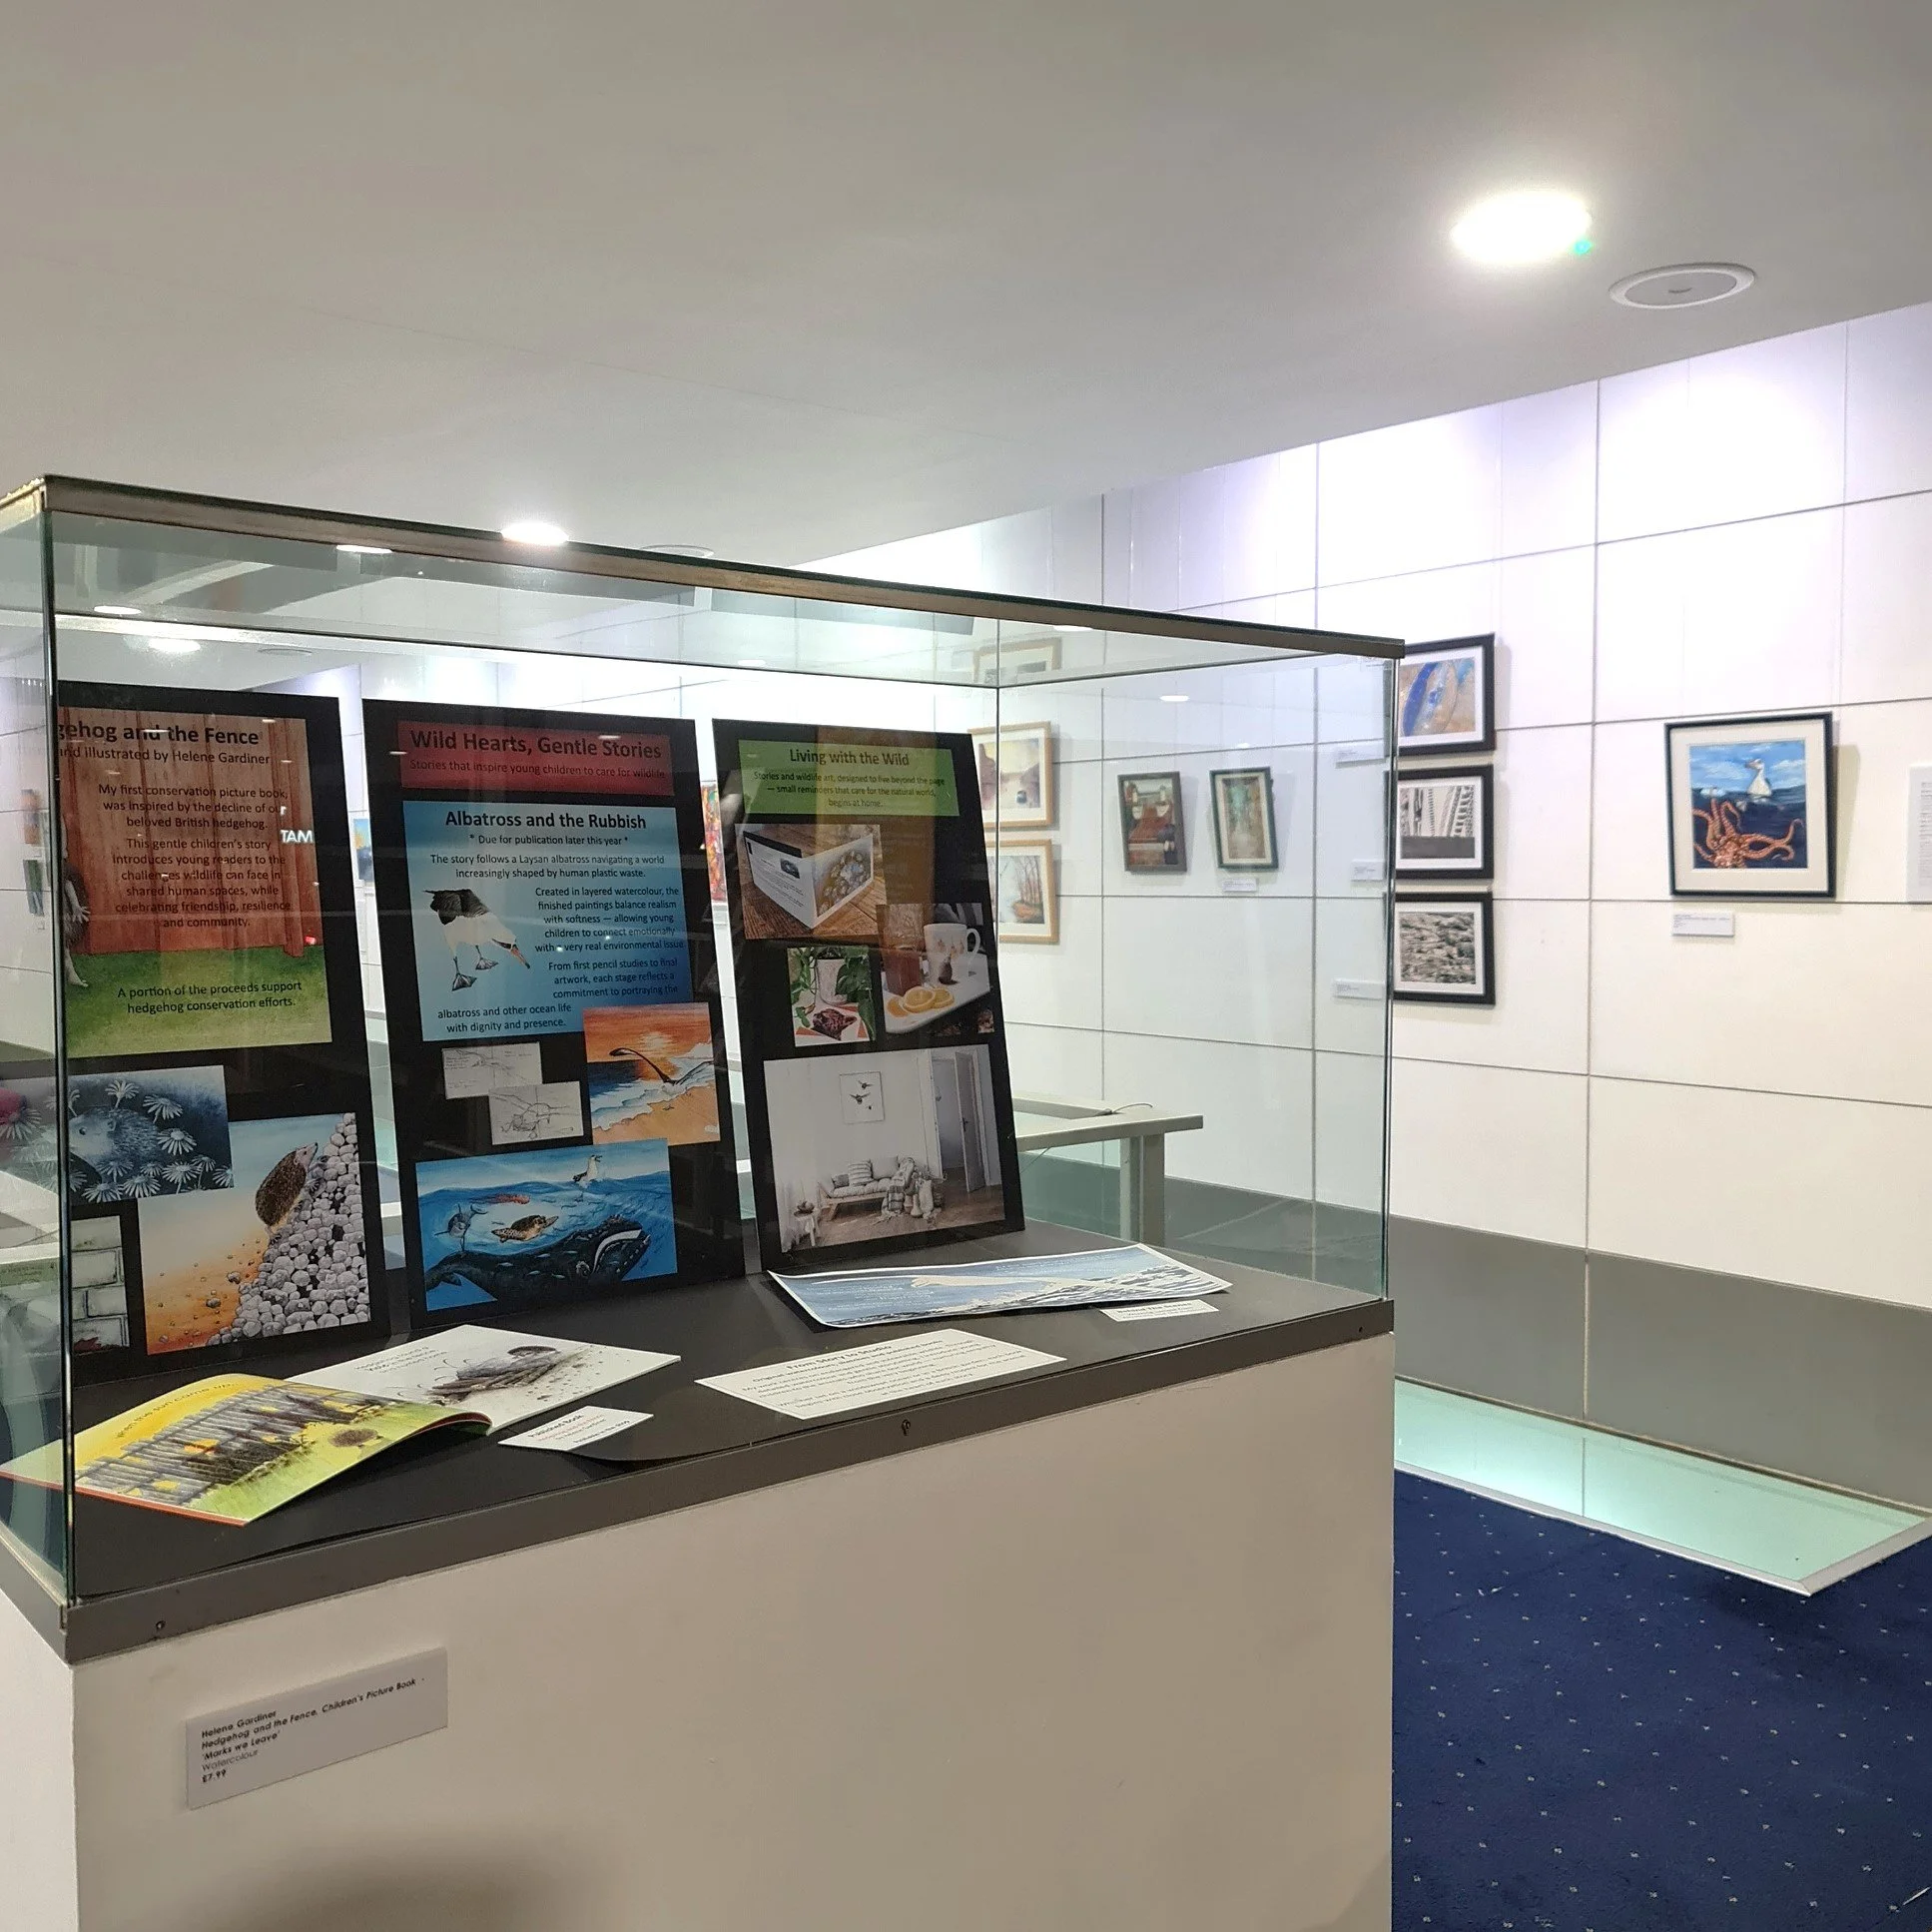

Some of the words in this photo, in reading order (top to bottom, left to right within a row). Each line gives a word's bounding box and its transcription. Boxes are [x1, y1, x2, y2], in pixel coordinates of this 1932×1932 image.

[123, 723, 160, 741] and
[168, 724, 199, 742] the
[205, 727, 260, 745] Fence
[410, 730, 456, 749] Wild
[463, 733, 532, 756] Hearts,
[537, 737, 597, 756] Gentle
[602, 739, 662, 759] Stories
[85, 746, 150, 761] illustrated
[154, 749, 169, 763] by
[172, 750, 216, 764] Helene
[218, 751, 271, 765] Gardiner
[790, 749, 826, 765] Living
[829, 751, 857, 763] with
[860, 752, 879, 764] the
[883, 754, 910, 766] Wild
[410, 760, 446, 771] Stories
[449, 761, 470, 771] that
[473, 763, 507, 774] inspire
[510, 765, 539, 775] young
[542, 764, 581, 775] children
[596, 768, 614, 777] care
[838, 774, 868, 783] designed
[99, 785, 117, 795] My
[121, 785, 142, 794] first
[146, 786, 216, 797] conservation
[220, 788, 256, 798] picture
[260, 787, 289, 799] book,
[129, 802, 174, 814] inspired
[178, 802, 190, 814] by
[215, 803, 252, 813] decline
[256, 804, 266, 813] of
[127, 817, 171, 827] beloved
[175, 817, 209, 827] British
[213, 819, 268, 830] hedgehog.
[445, 811, 521, 827] Albatross
[526, 812, 554, 827] and
[559, 814, 584, 828] the
[589, 815, 646, 829] Rubbish
[127, 839, 149, 849] This
[153, 839, 187, 850] gentle
[245, 841, 271, 851] story
[478, 835, 496, 844] Due
[499, 835, 511, 845] for
[515, 836, 564, 846] publication
[566, 836, 585, 845] later
[587, 836, 602, 845] this
[604, 838, 621, 847] year
[113, 855, 173, 865] introduces
[176, 857, 210, 866] young
[213, 856, 251, 865] readers
[256, 856, 266, 865] to
[270, 855, 285, 865] the
[430, 855, 448, 864] The
[451, 856, 474, 866] story
[477, 855, 509, 864] follows
[519, 855, 548, 866] Laysan
[551, 855, 589, 864] albatross
[592, 856, 633, 866] navigating
[247, 871, 268, 880] face
[455, 869, 510, 880] increasingly
[512, 869, 544, 880] shaped
[547, 869, 558, 879] by
[559, 869, 589, 878] human
[592, 869, 618, 880] plastic
[127, 887, 164, 896] shared
[168, 887, 207, 896] human
[251, 886, 279, 895] while
[582, 888, 612, 897] layered
[615, 888, 664, 897] watercolour,
[116, 902, 178, 914] celebrating
[243, 902, 291, 911] resilience
[575, 902, 613, 911] paintings
[164, 918, 183, 928] and
[544, 915, 563, 924] with
[614, 915, 647, 924] allowing
[545, 929, 579, 938] children
[535, 944, 554, 953] with
[585, 942, 601, 951] real
[604, 941, 662, 950] environmental
[593, 961, 617, 970] pencil
[620, 960, 648, 968] studies
[554, 974, 590, 984] artwork,
[593, 973, 612, 982] each
[615, 973, 636, 982] stage
[639, 971, 668, 981] reflects
[118, 987, 126, 997] A
[130, 986, 171, 999] portion
[174, 984, 186, 995] of
[189, 984, 206, 995] the
[210, 982, 259, 995] proceeds
[262, 981, 302, 992] support
[553, 988, 608, 998] commitment
[128, 1003, 184, 1014] hedgehog
[187, 999, 256, 1010] conservation
[259, 997, 296, 1006] efforts.
[438, 1008, 480, 1018] albatross
[483, 1006, 499, 1016] and
[502, 1005, 527, 1015] other
[530, 1005, 555, 1014] ocean
[558, 1003, 571, 1012] life
[447, 1023, 468, 1032] with
[470, 1021, 501, 1032] dignity
[504, 1020, 520, 1029] and
[524, 1019, 566, 1029] presence.
[202, 1730, 250, 1749] Hedgehog
[254, 1723, 271, 1734] and
[274, 1718, 287, 1728] the
[366, 1685, 393, 1699] Picture
[396, 1678, 415, 1690] Book
[202, 1724, 234, 1738] Helene
[238, 1710, 277, 1728] Gardiner
[235, 1741, 248, 1750] we
[202, 1749, 258, 1772] Watercolour
[202, 1769, 226, 1783] £7.99
